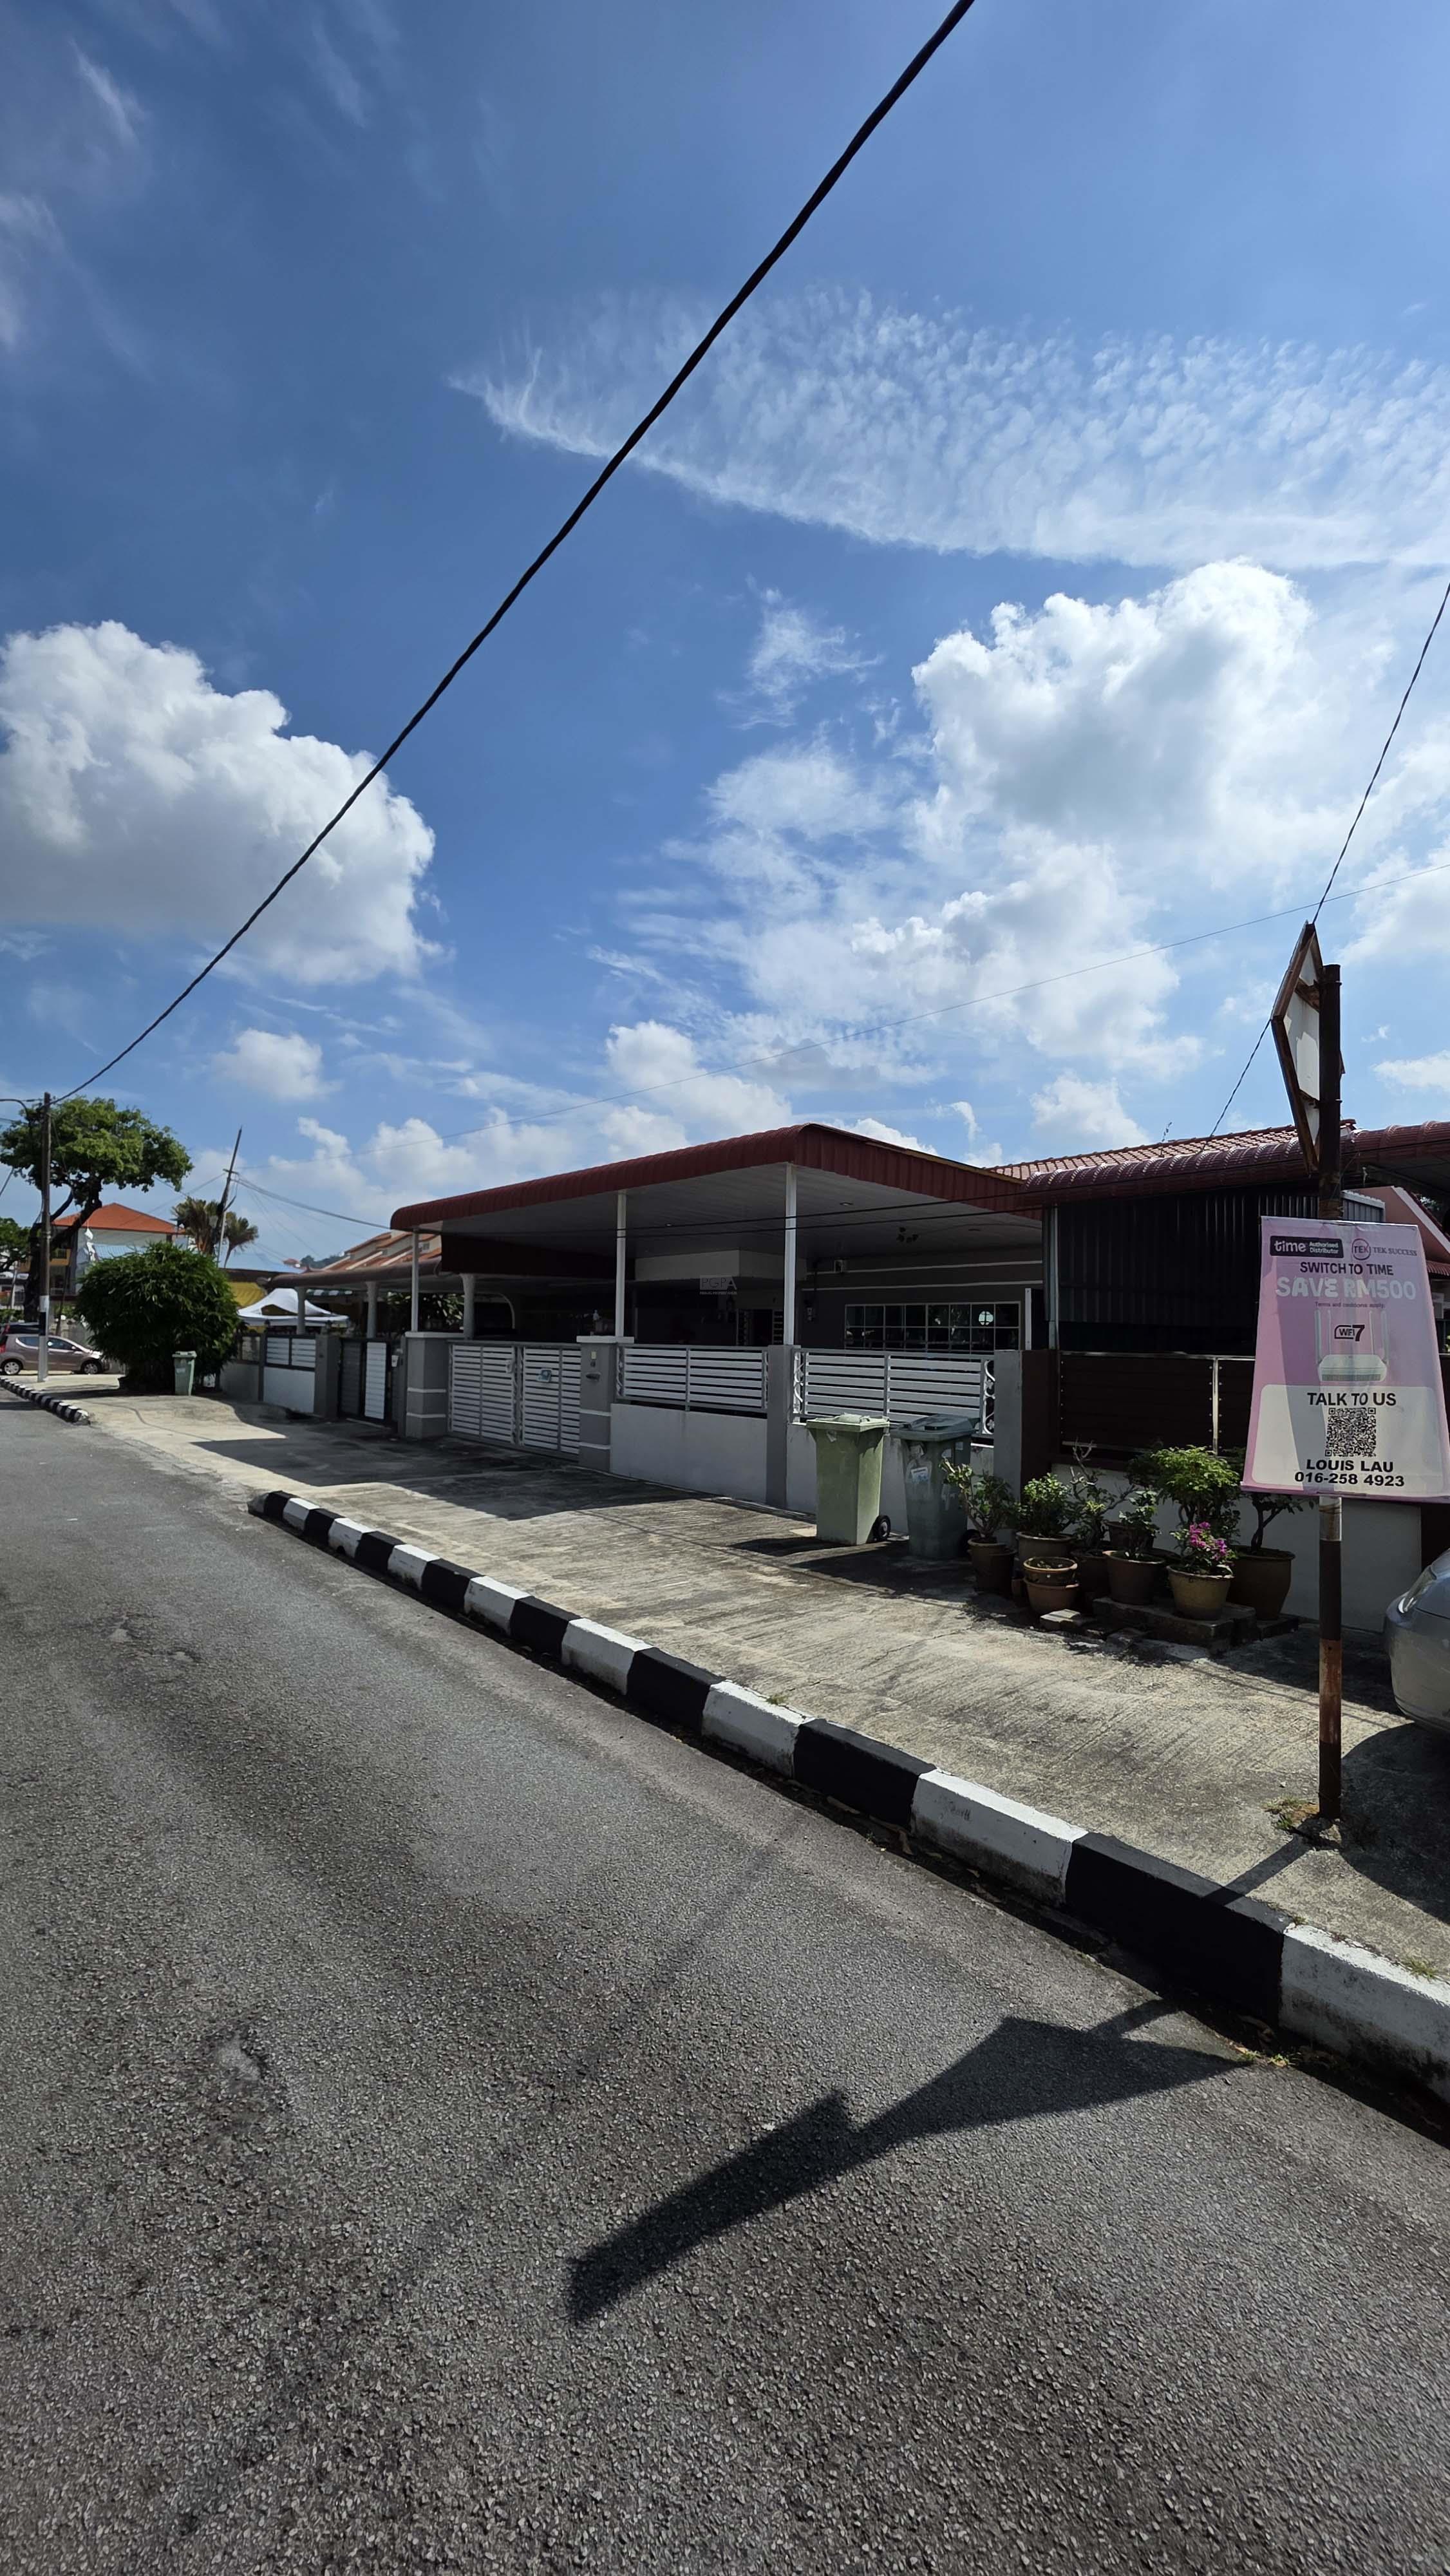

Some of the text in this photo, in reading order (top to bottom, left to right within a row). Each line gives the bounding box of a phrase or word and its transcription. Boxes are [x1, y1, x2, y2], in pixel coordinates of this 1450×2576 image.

[1274, 1240, 1306, 1252] time
[1388, 1248, 1417, 1256] SUCCESS
[1300, 1262, 1394, 1276] SWITCH TO TIME
[1276, 1277, 1416, 1300] SAVE RM500
[1352, 1325, 1365, 1341] 7
[1307, 1392, 1397, 1406] TALK TO US
[1306, 1459, 1394, 1472] LOUIS LAU
[1294, 1472, 1405, 1487] 016-258 4923
